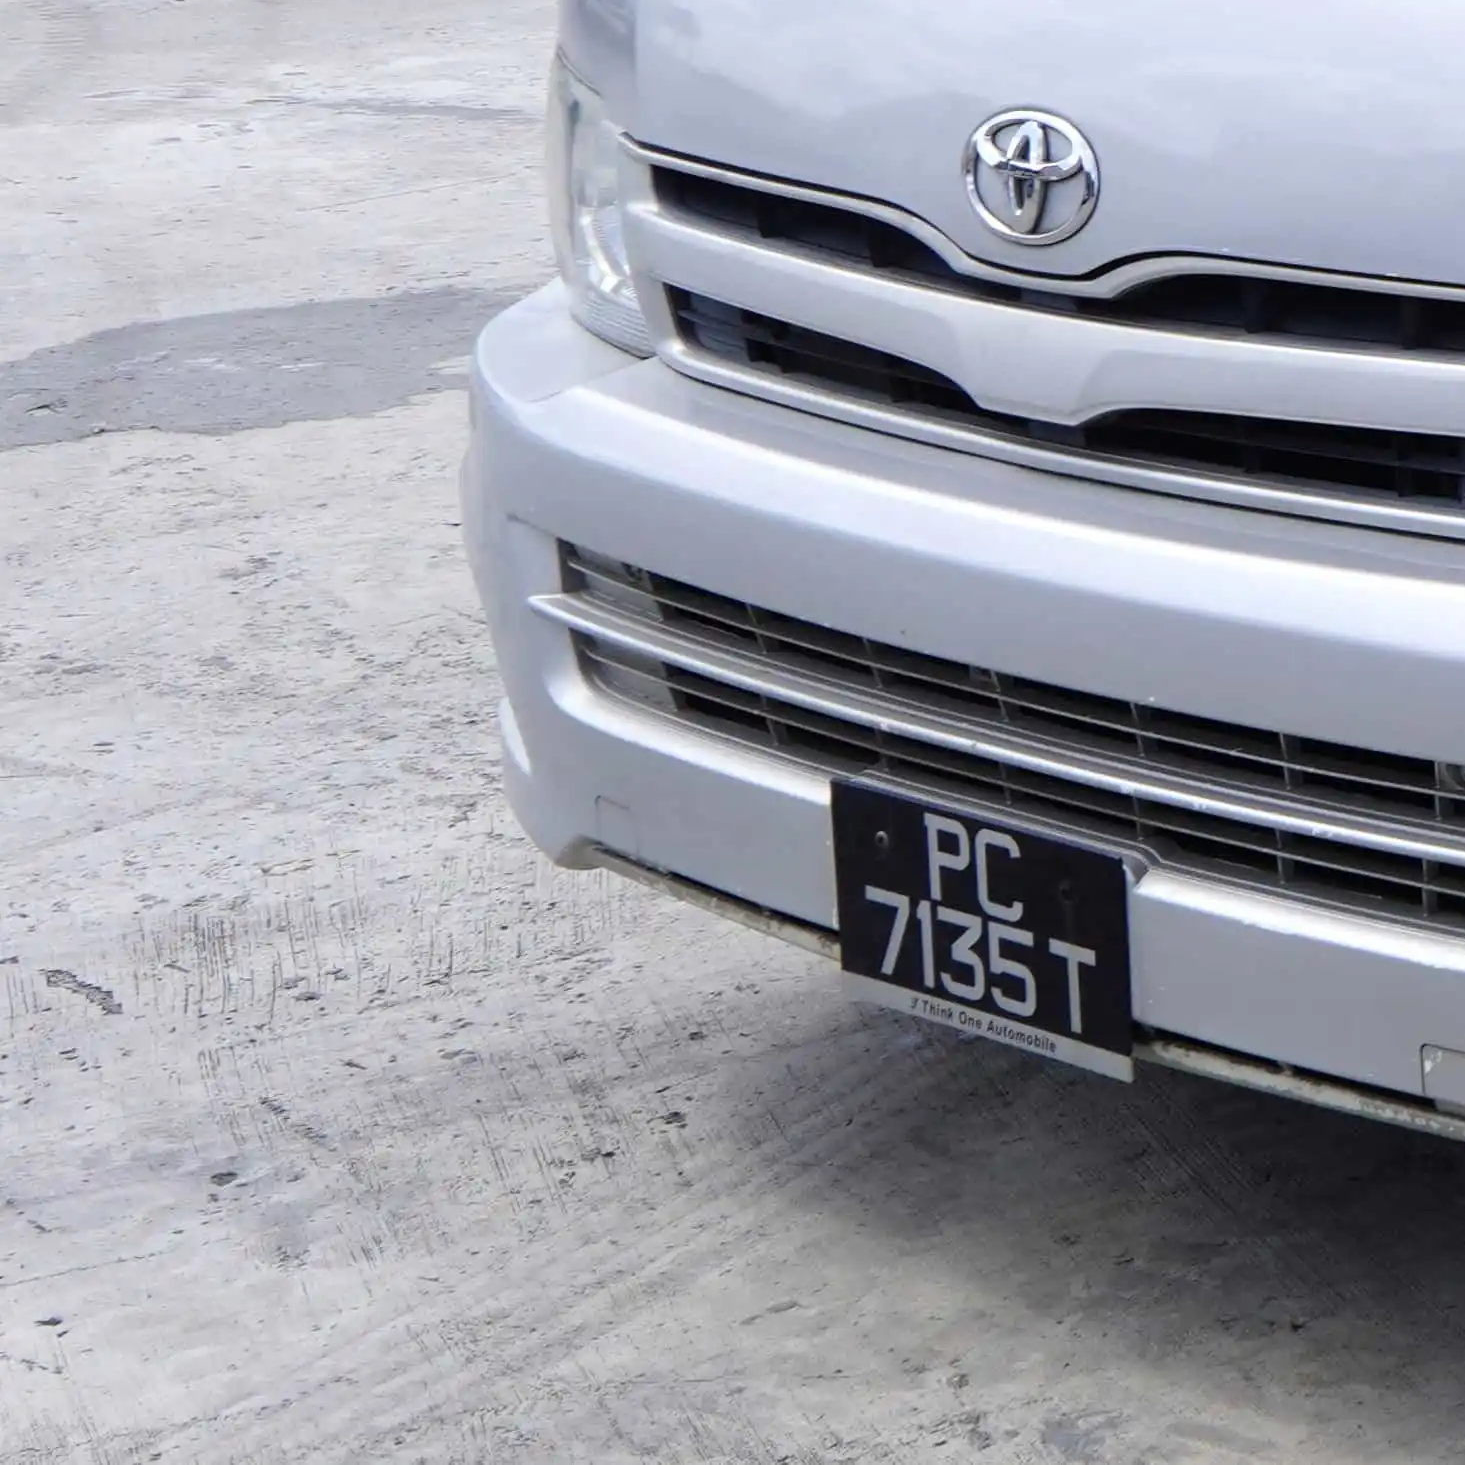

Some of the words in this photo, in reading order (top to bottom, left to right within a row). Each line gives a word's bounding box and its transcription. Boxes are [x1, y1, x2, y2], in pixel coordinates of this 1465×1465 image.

[922, 812, 1024, 923] PC
[921, 999, 954, 1020] Think
[958, 1011, 983, 1030] One
[987, 1021, 1058, 1053] Automobile
